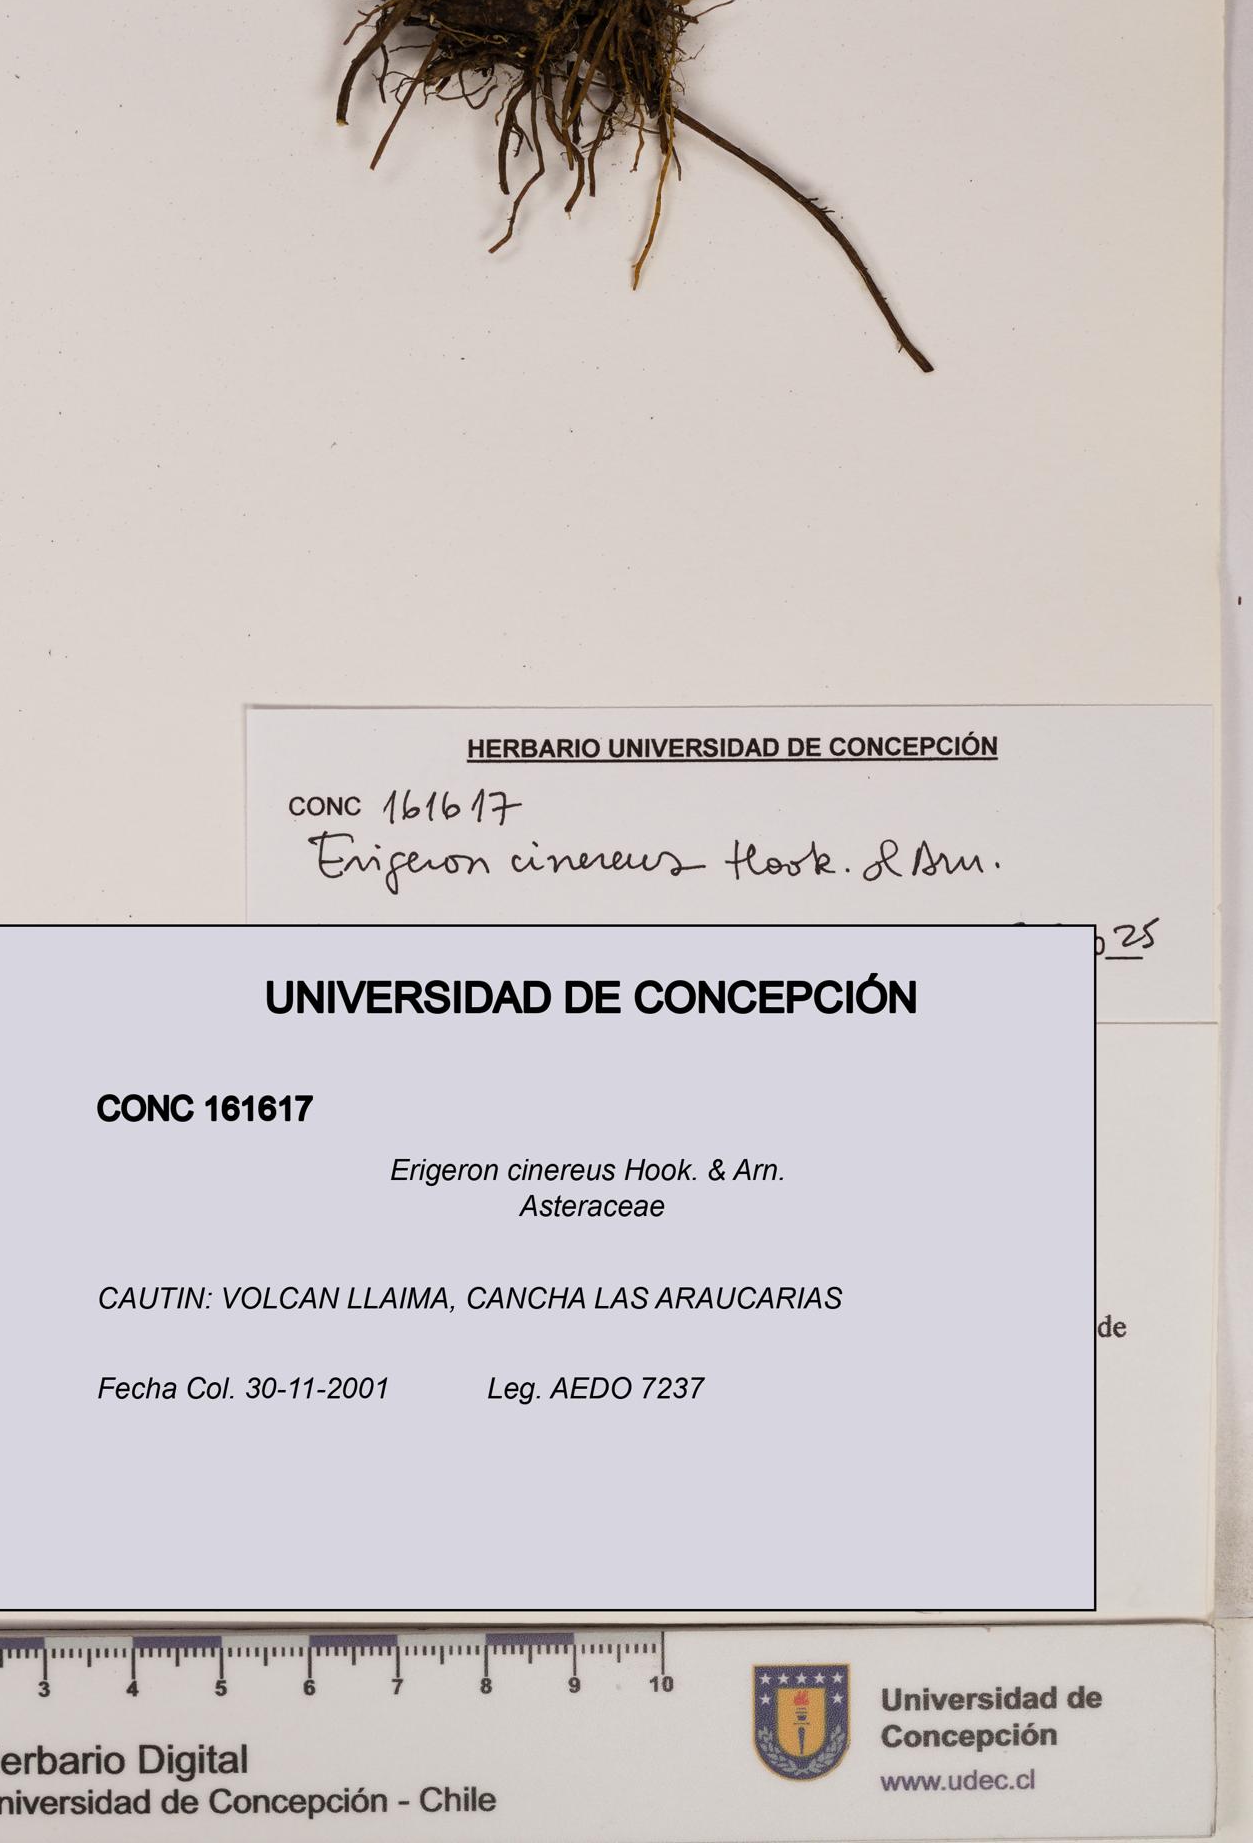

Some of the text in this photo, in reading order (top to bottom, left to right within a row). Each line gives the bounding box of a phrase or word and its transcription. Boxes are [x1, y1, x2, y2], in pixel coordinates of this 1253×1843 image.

[468, 730, 998, 759] HERBARIO UNIVERSIDAD DE CONCEPCIÓN
[288, 788, 523, 826] CONC 161617
[307, 830, 490, 895] Erigeron
[511, 840, 707, 876] cinereus
[1097, 1313, 1127, 1338] de
[37, 1680, 51, 1698] 3
[126, 1680, 140, 1697] 4
[214, 1679, 228, 1697] 5
[303, 1678, 316, 1696] 6
[391, 1677, 404, 1695] 7
[480, 1676, 493, 1695] 8
[568, 1676, 581, 1694] 9
[649, 1675, 674, 1694] 10
[881, 1684, 1104, 1713] Universidad de
[881, 1720, 1059, 1753] Concepción
[138, 1743, 249, 1784] Digital
[880, 1768, 1036, 1793] www.udec.cl
[160, 1788, 200, 1815] de
[208, 1787, 389, 1820] Concepción
[419, 1785, 498, 1814] Chile
